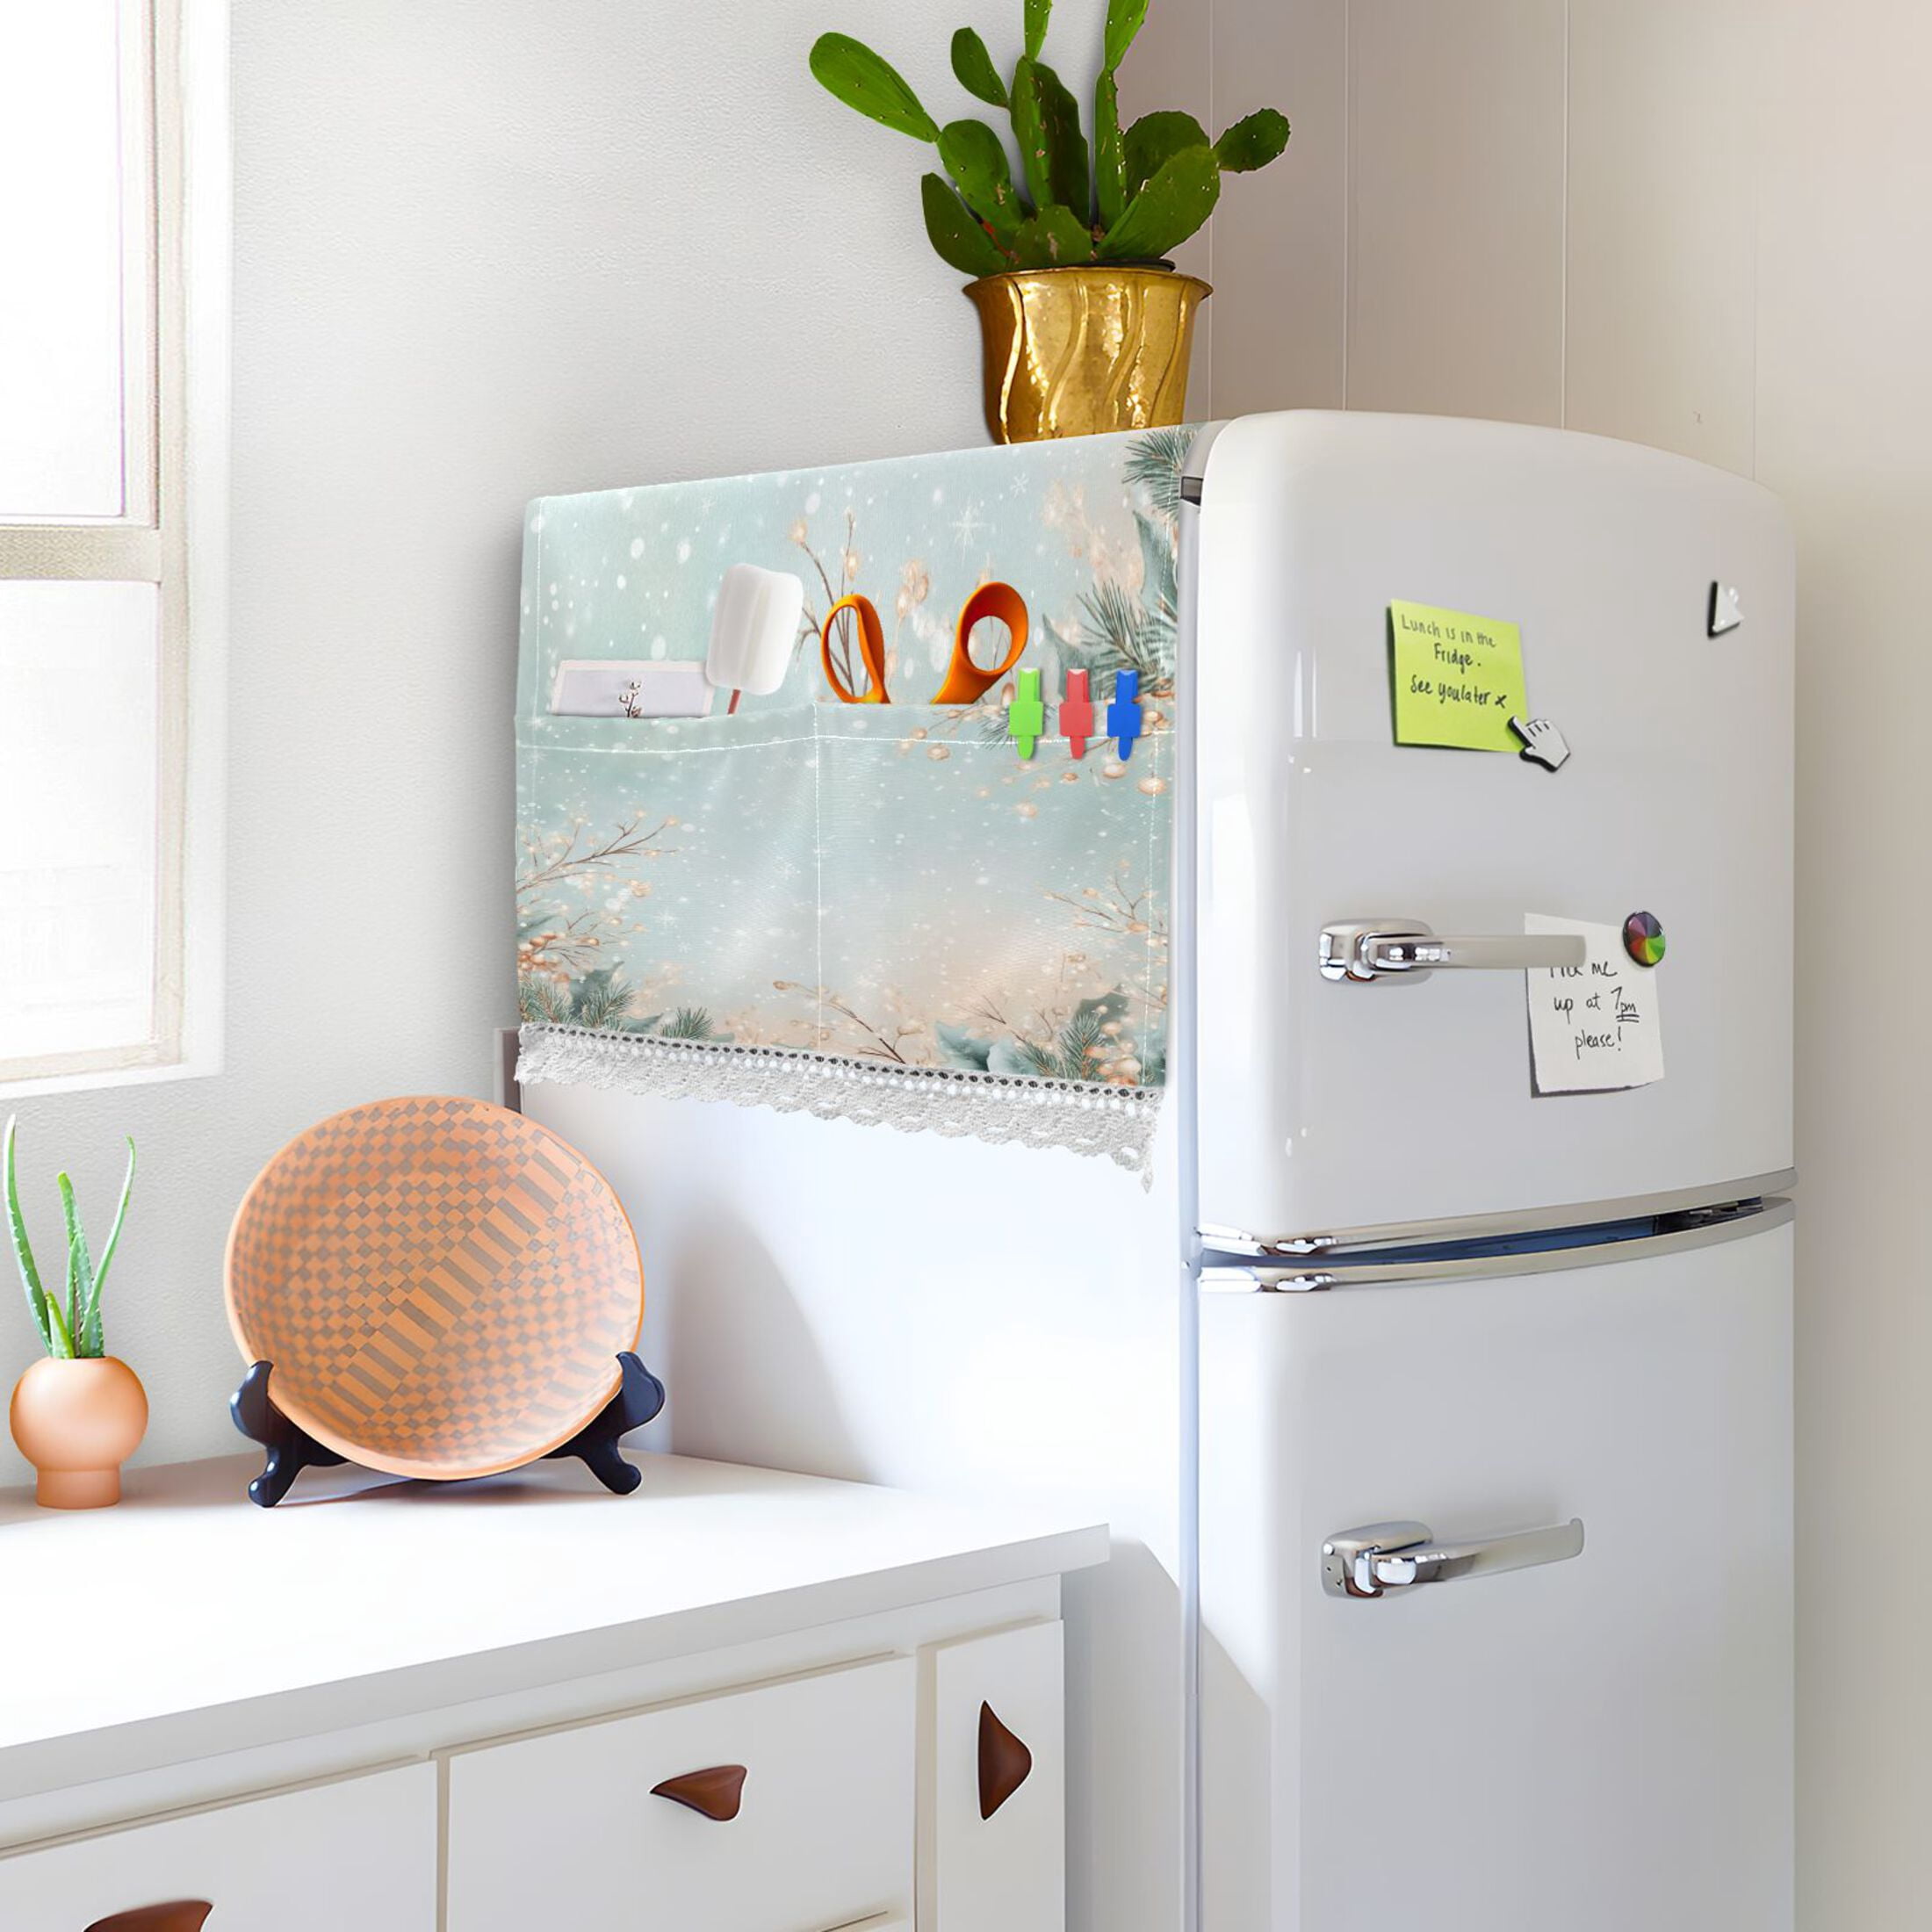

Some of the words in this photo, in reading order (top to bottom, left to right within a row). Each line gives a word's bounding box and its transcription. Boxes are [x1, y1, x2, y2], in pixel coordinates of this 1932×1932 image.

[1402, 614, 1441, 638] Lunch
[1460, 631, 1474, 644] in
[1476, 631, 1496, 648] the
[1410, 674, 1433, 695] See
[1591, 961, 1618, 977] me
[1554, 997, 1574, 1025] up
[1586, 992, 1601, 1011] at
[1575, 1026, 1622, 1061] please!
